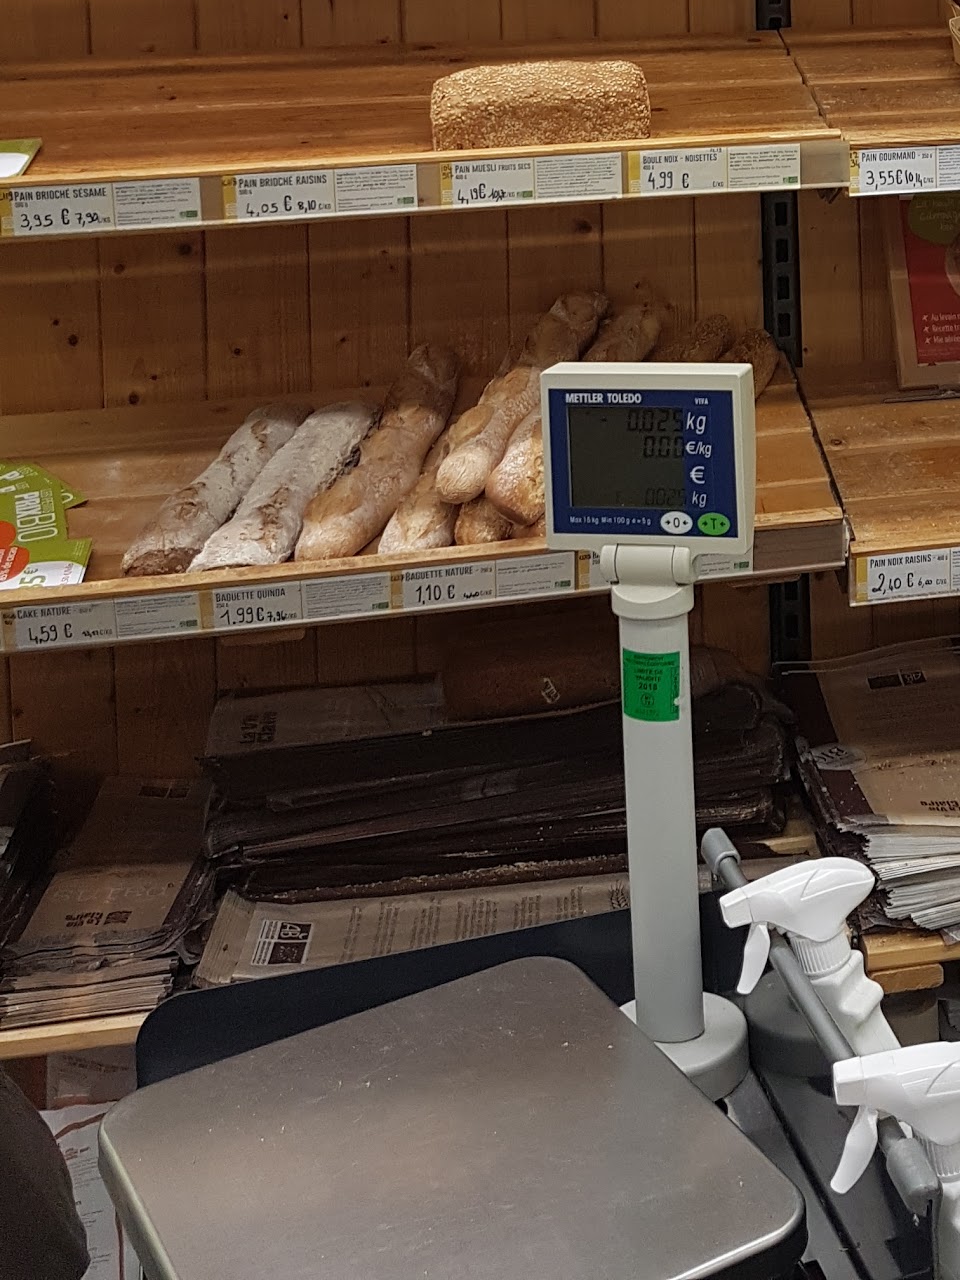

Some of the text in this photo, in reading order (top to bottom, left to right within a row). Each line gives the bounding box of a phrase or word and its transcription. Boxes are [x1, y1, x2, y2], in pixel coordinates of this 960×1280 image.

[643, 153, 718, 165] BOULE NOIX NOISETTES
[861, 151, 916, 163] PAIN GOURMAND
[454, 164, 470, 174] PAIN
[472, 163, 497, 173] MUESLI
[238, 174, 327, 188] PAIN RAISINS
[14, 191, 33, 201] PAIN
[246, 202, 279, 217] 4,05
[20, 213, 53, 231] 3,95
[565, 392, 642, 404] METTLER TOLEDO
[686, 412, 707, 435] kg
[685, 441, 712, 458] €/kg
[690, 466, 706, 484] €
[691, 491, 708, 507] kg
[870, 553, 931, 568] PAIN NOIX RAISINS
[405, 565, 472, 581] BAGUETTE NATURE
[215, 587, 286, 602] BAGUETTE QUINOA
[415, 584, 442, 604] 1,10
[17, 606, 71, 620] CAKE NATURE
[28, 624, 58, 644] 4,59
